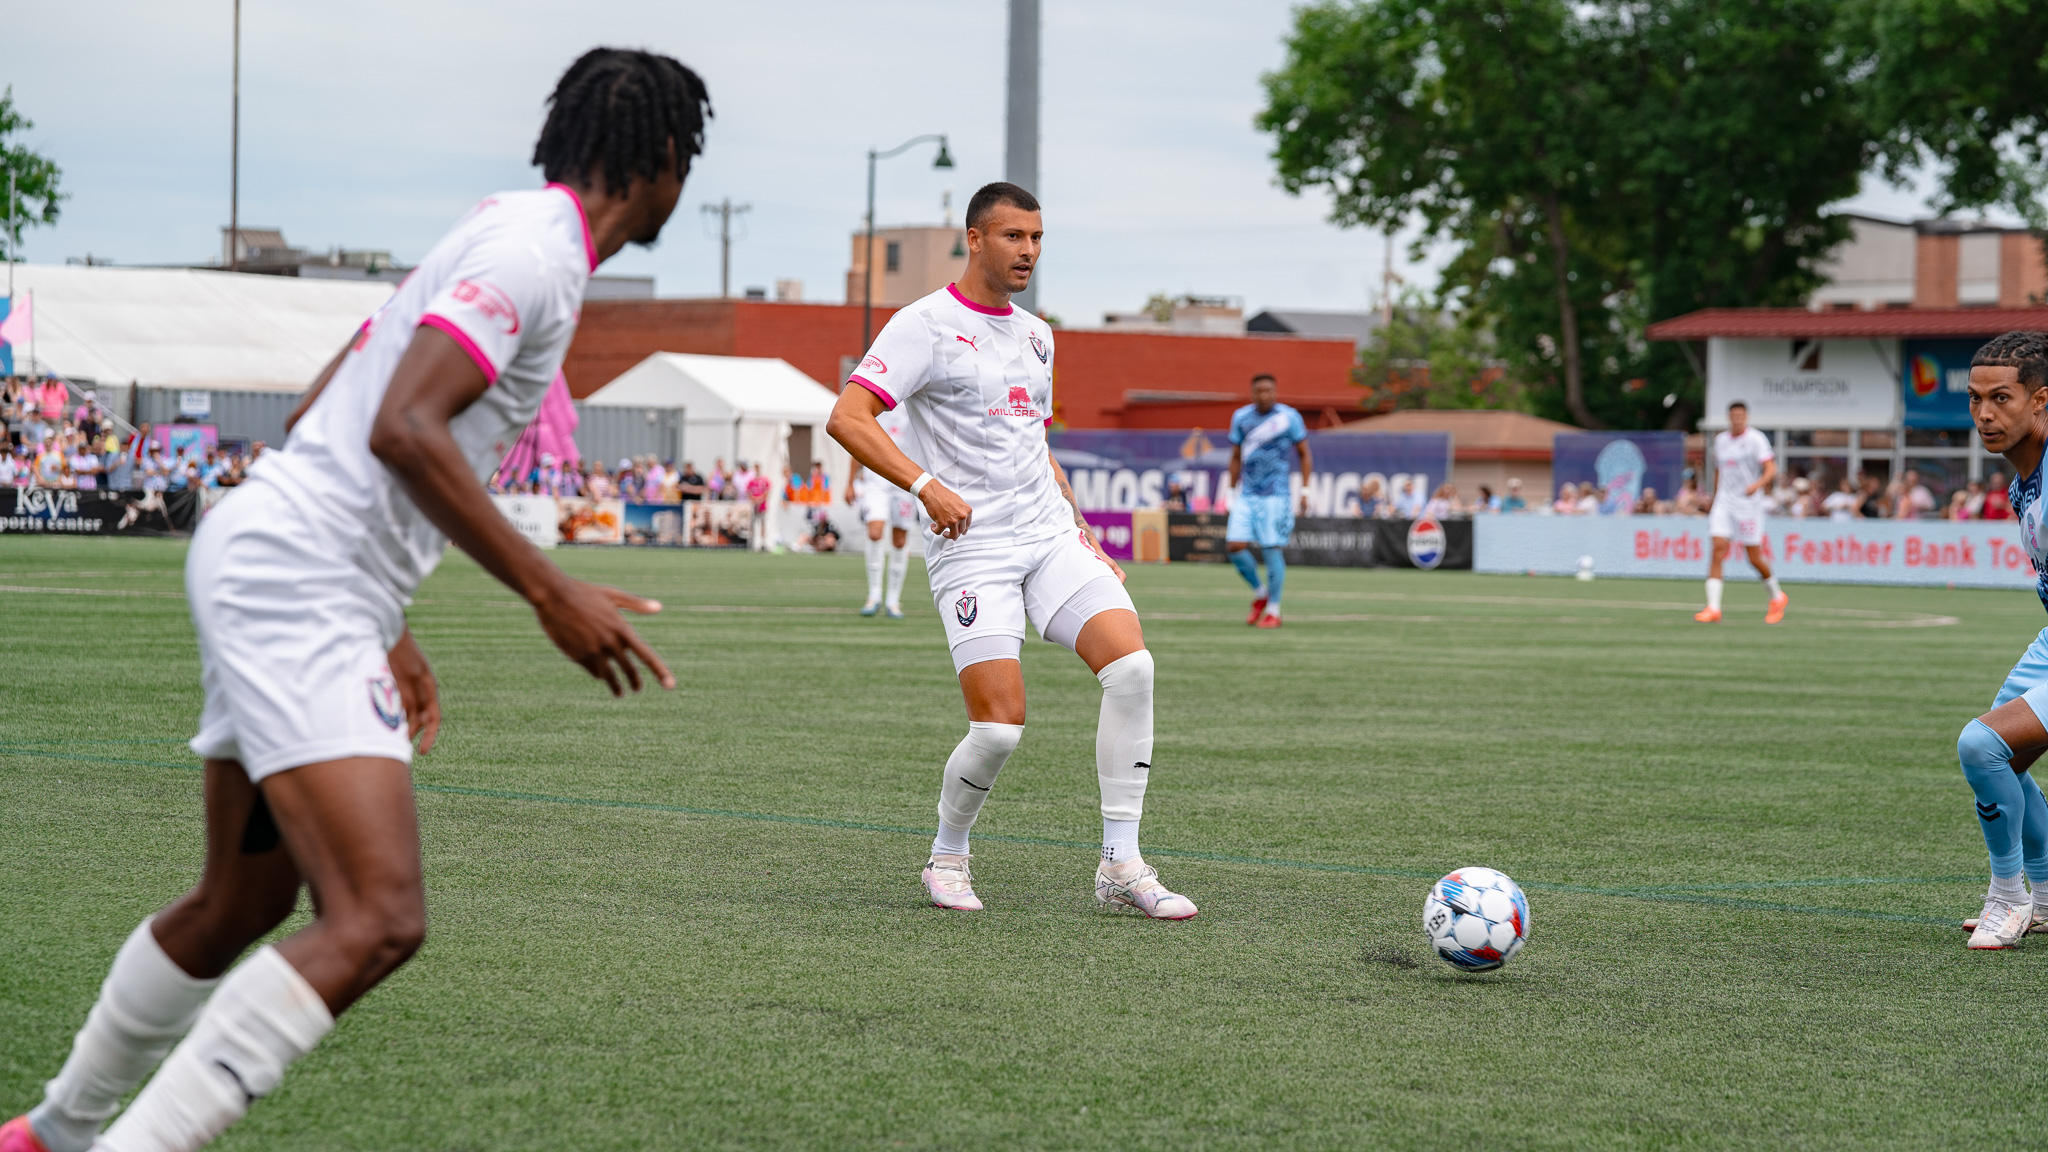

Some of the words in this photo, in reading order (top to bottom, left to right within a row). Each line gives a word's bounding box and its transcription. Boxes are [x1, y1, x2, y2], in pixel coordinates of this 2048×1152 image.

[1761, 377, 1851, 398] THOMPSON
[47, 515, 103, 531] center
[1635, 530, 1703, 561] Birds
[1785, 532, 1893, 566] Feather
[1905, 534, 1976, 568] Bank
